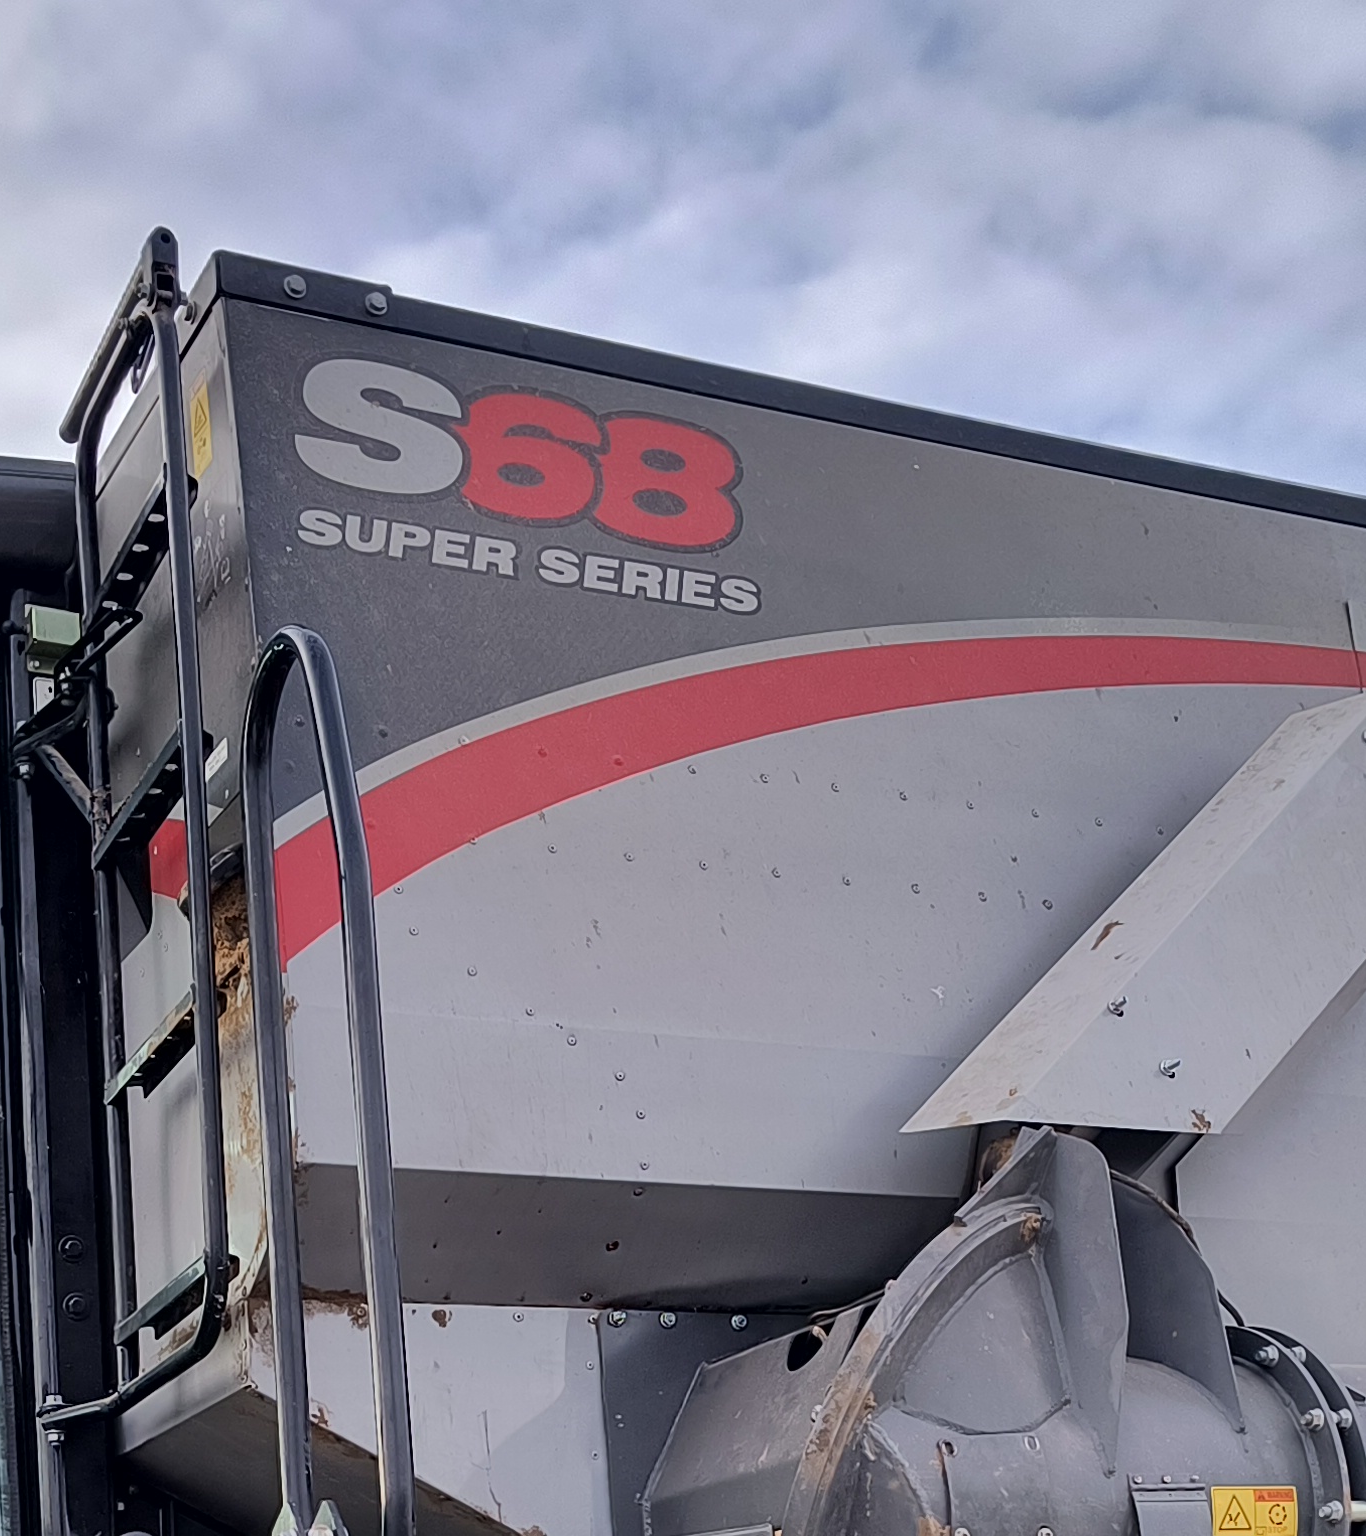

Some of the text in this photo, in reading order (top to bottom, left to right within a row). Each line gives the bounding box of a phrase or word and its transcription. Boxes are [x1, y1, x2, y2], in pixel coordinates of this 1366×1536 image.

[294, 357, 741, 549] S68
[297, 508, 760, 614] SUPER SERIES
